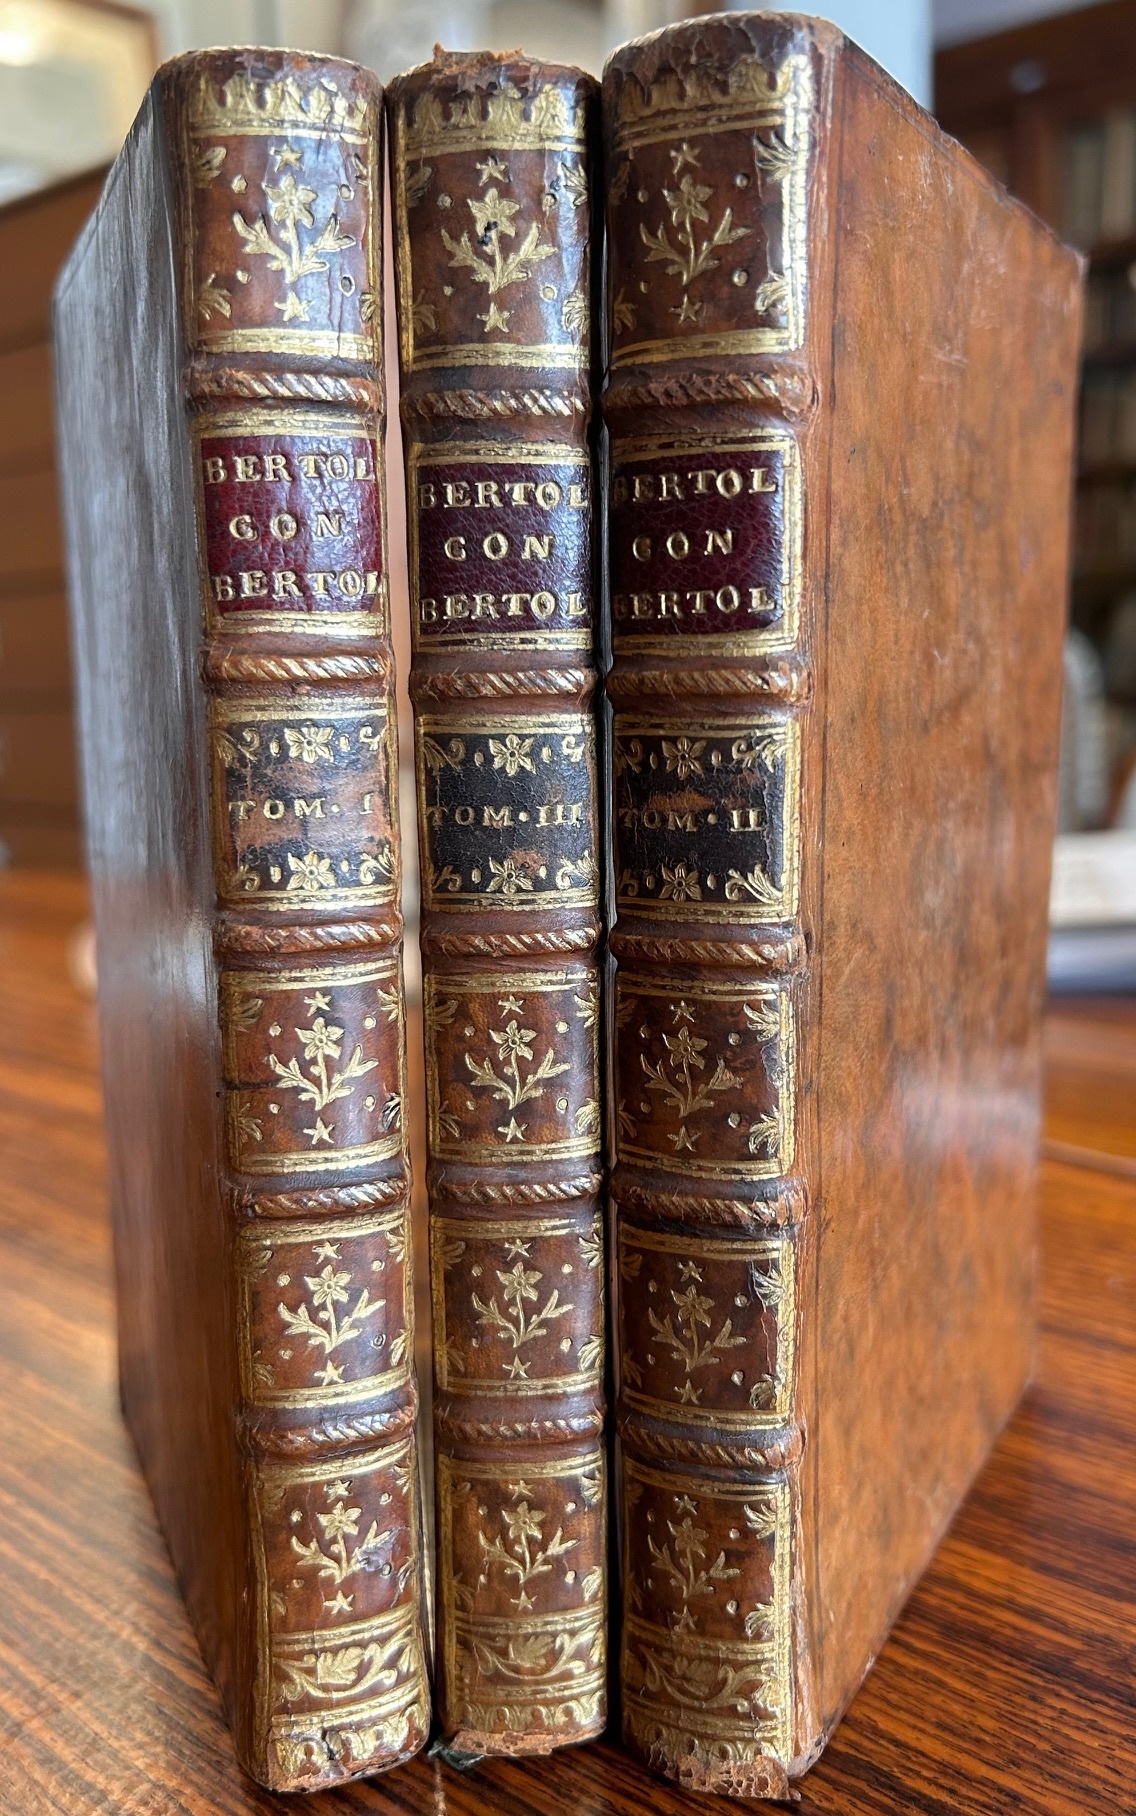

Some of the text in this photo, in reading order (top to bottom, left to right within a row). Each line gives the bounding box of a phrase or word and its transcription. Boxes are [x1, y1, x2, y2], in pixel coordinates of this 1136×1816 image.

[203, 454, 376, 484] BERTOL
[418, 481, 588, 510] BERTOL
[229, 512, 343, 541] CON
[444, 531, 554, 561] CON
[632, 529, 734, 562] CON
[214, 569, 383, 602] BERTOL
[419, 591, 587, 623] BERTOL
